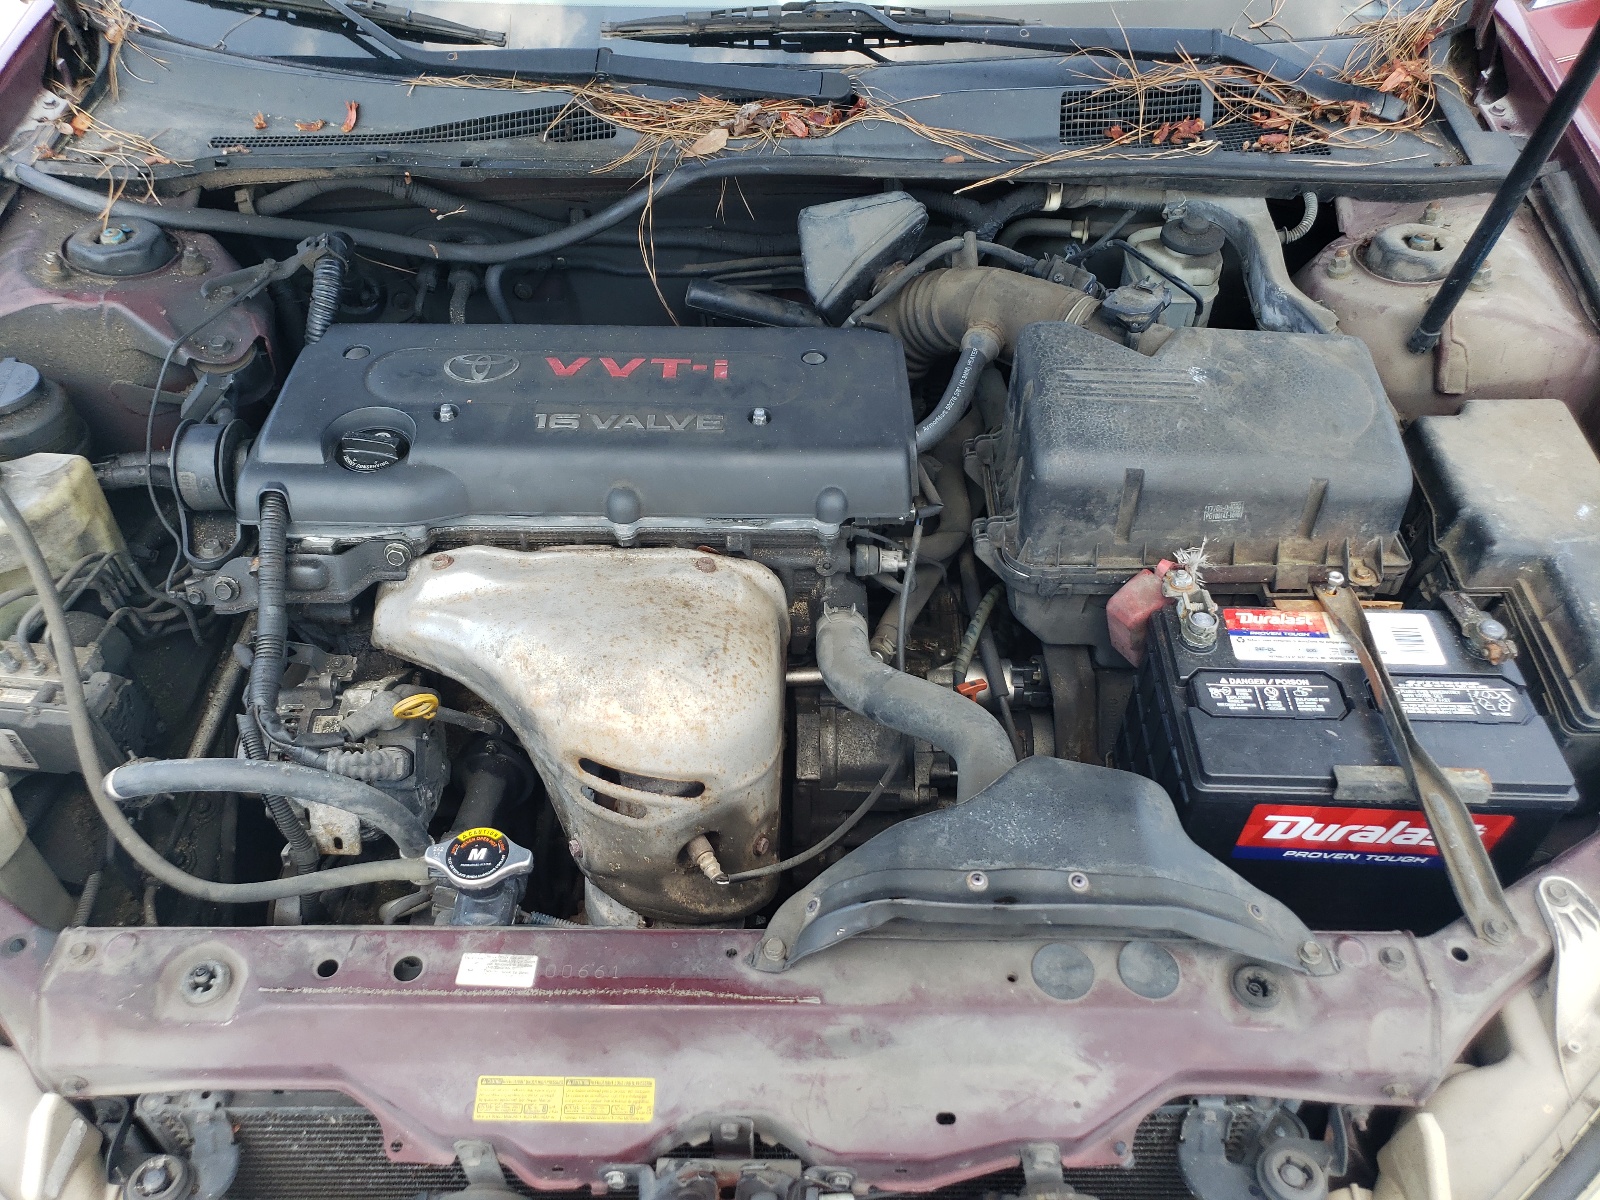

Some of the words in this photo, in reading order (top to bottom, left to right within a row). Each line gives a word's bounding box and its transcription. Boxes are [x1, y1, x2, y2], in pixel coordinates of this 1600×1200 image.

[545, 356, 729, 380] VVT-i
[534, 413, 581, 431] 16
[590, 414, 725, 432] VALVE
[1235, 612, 1314, 626] Duralast
[1229, 677, 1266, 685] DANGER
[1276, 678, 1310, 686] POISON
[468, 829, 499, 838] CAUTION
[1262, 815, 1488, 846] Durala
[467, 847, 488, 861] M
[1282, 850, 1361, 861] PROVEN
[1365, 854, 1430, 864] TOUGH
[545, 964, 619, 979] 00661
